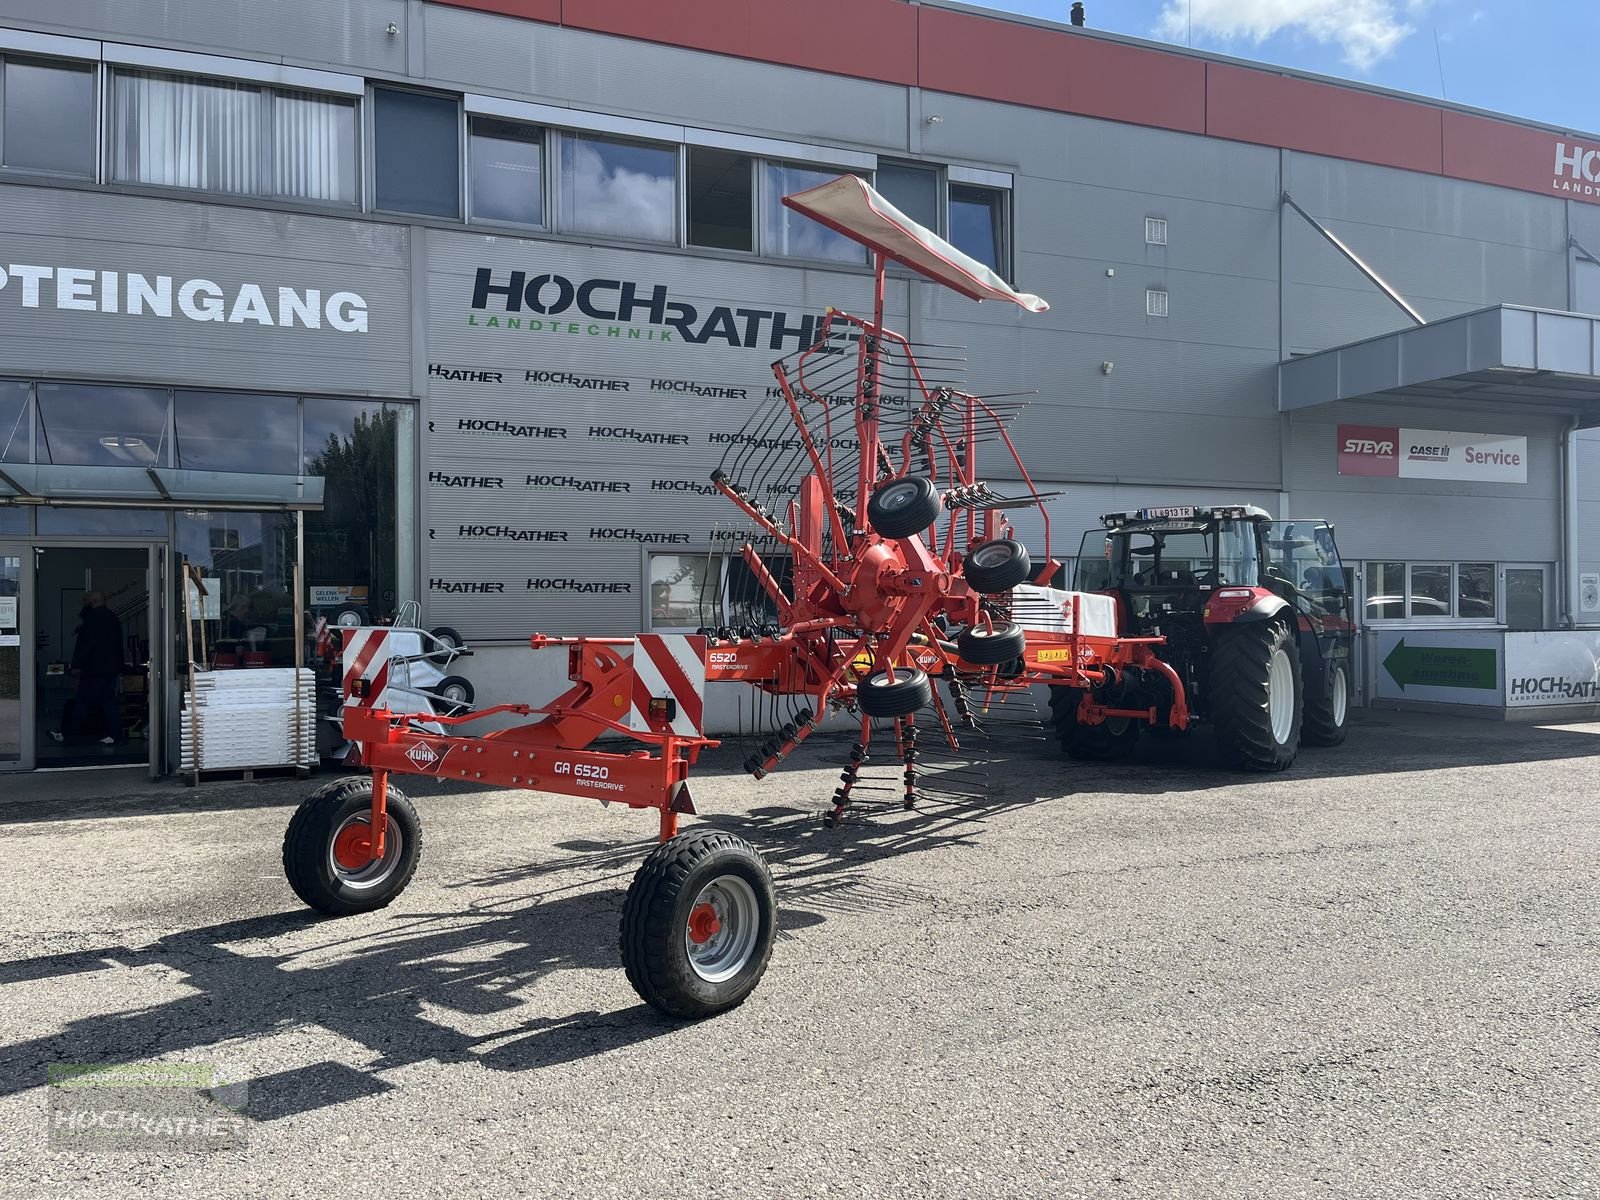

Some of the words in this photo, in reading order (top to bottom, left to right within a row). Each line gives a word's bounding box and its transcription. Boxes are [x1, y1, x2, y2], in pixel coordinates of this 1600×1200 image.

[469, 314, 673, 342] LANDTECHNIK
[525, 370, 630, 391] HOCHRATHER
[650, 379, 747, 399] HOCHRATHER
[458, 419, 567, 439] HOCHRATHER
[588, 426, 689, 445] HOCHRATHER
[709, 433, 801, 450] HOCHRATHER
[1344, 439, 1394, 455] STEYR
[1410, 445, 1440, 456] CASE
[1465, 446, 1520, 466] Service
[526, 475, 631, 493] HOCHRATHER
[458, 525, 568, 542] HOCHRATHER
[589, 528, 690, 544] HOCHRATHER
[527, 578, 631, 593] HOCHRATHER
[710, 653, 737, 663] 6520
[410, 749, 434, 762] KUHN
[554, 761, 571, 775] GA
[574, 764, 609, 780] 6520
[576, 779, 624, 792] MASTERDRIVE
